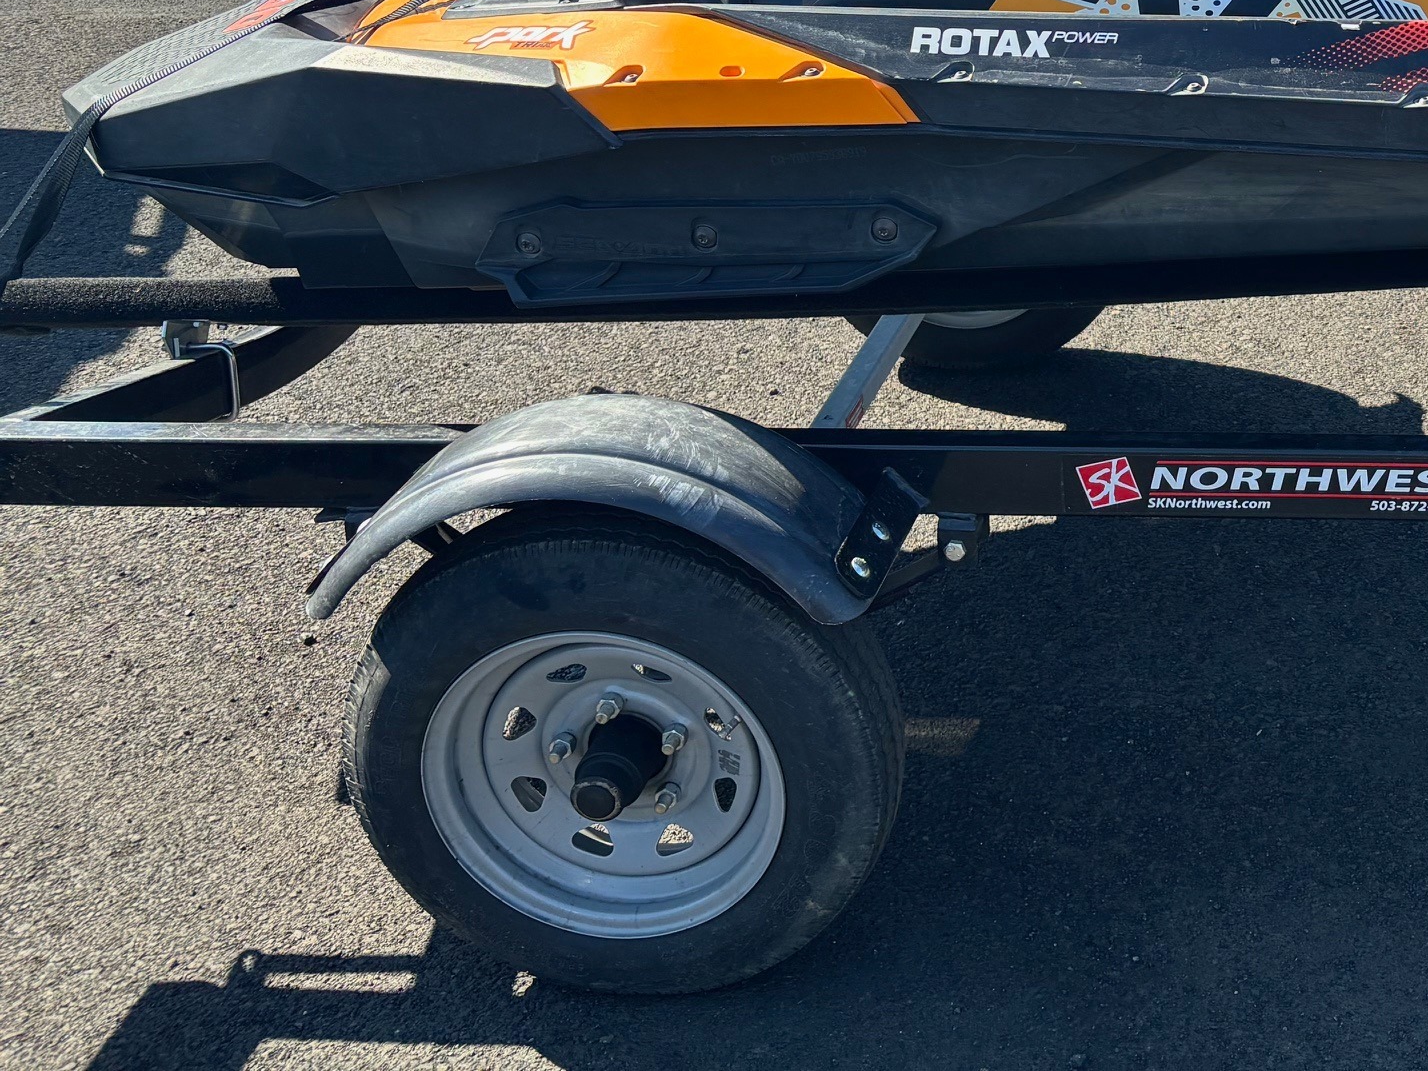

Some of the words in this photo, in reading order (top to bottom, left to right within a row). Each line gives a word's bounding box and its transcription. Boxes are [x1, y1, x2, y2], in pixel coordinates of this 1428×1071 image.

[909, 26, 1053, 58] ROTAX
[1051, 31, 1120, 45] POWER
[1147, 497, 1271, 510] SKNorthwest.com
